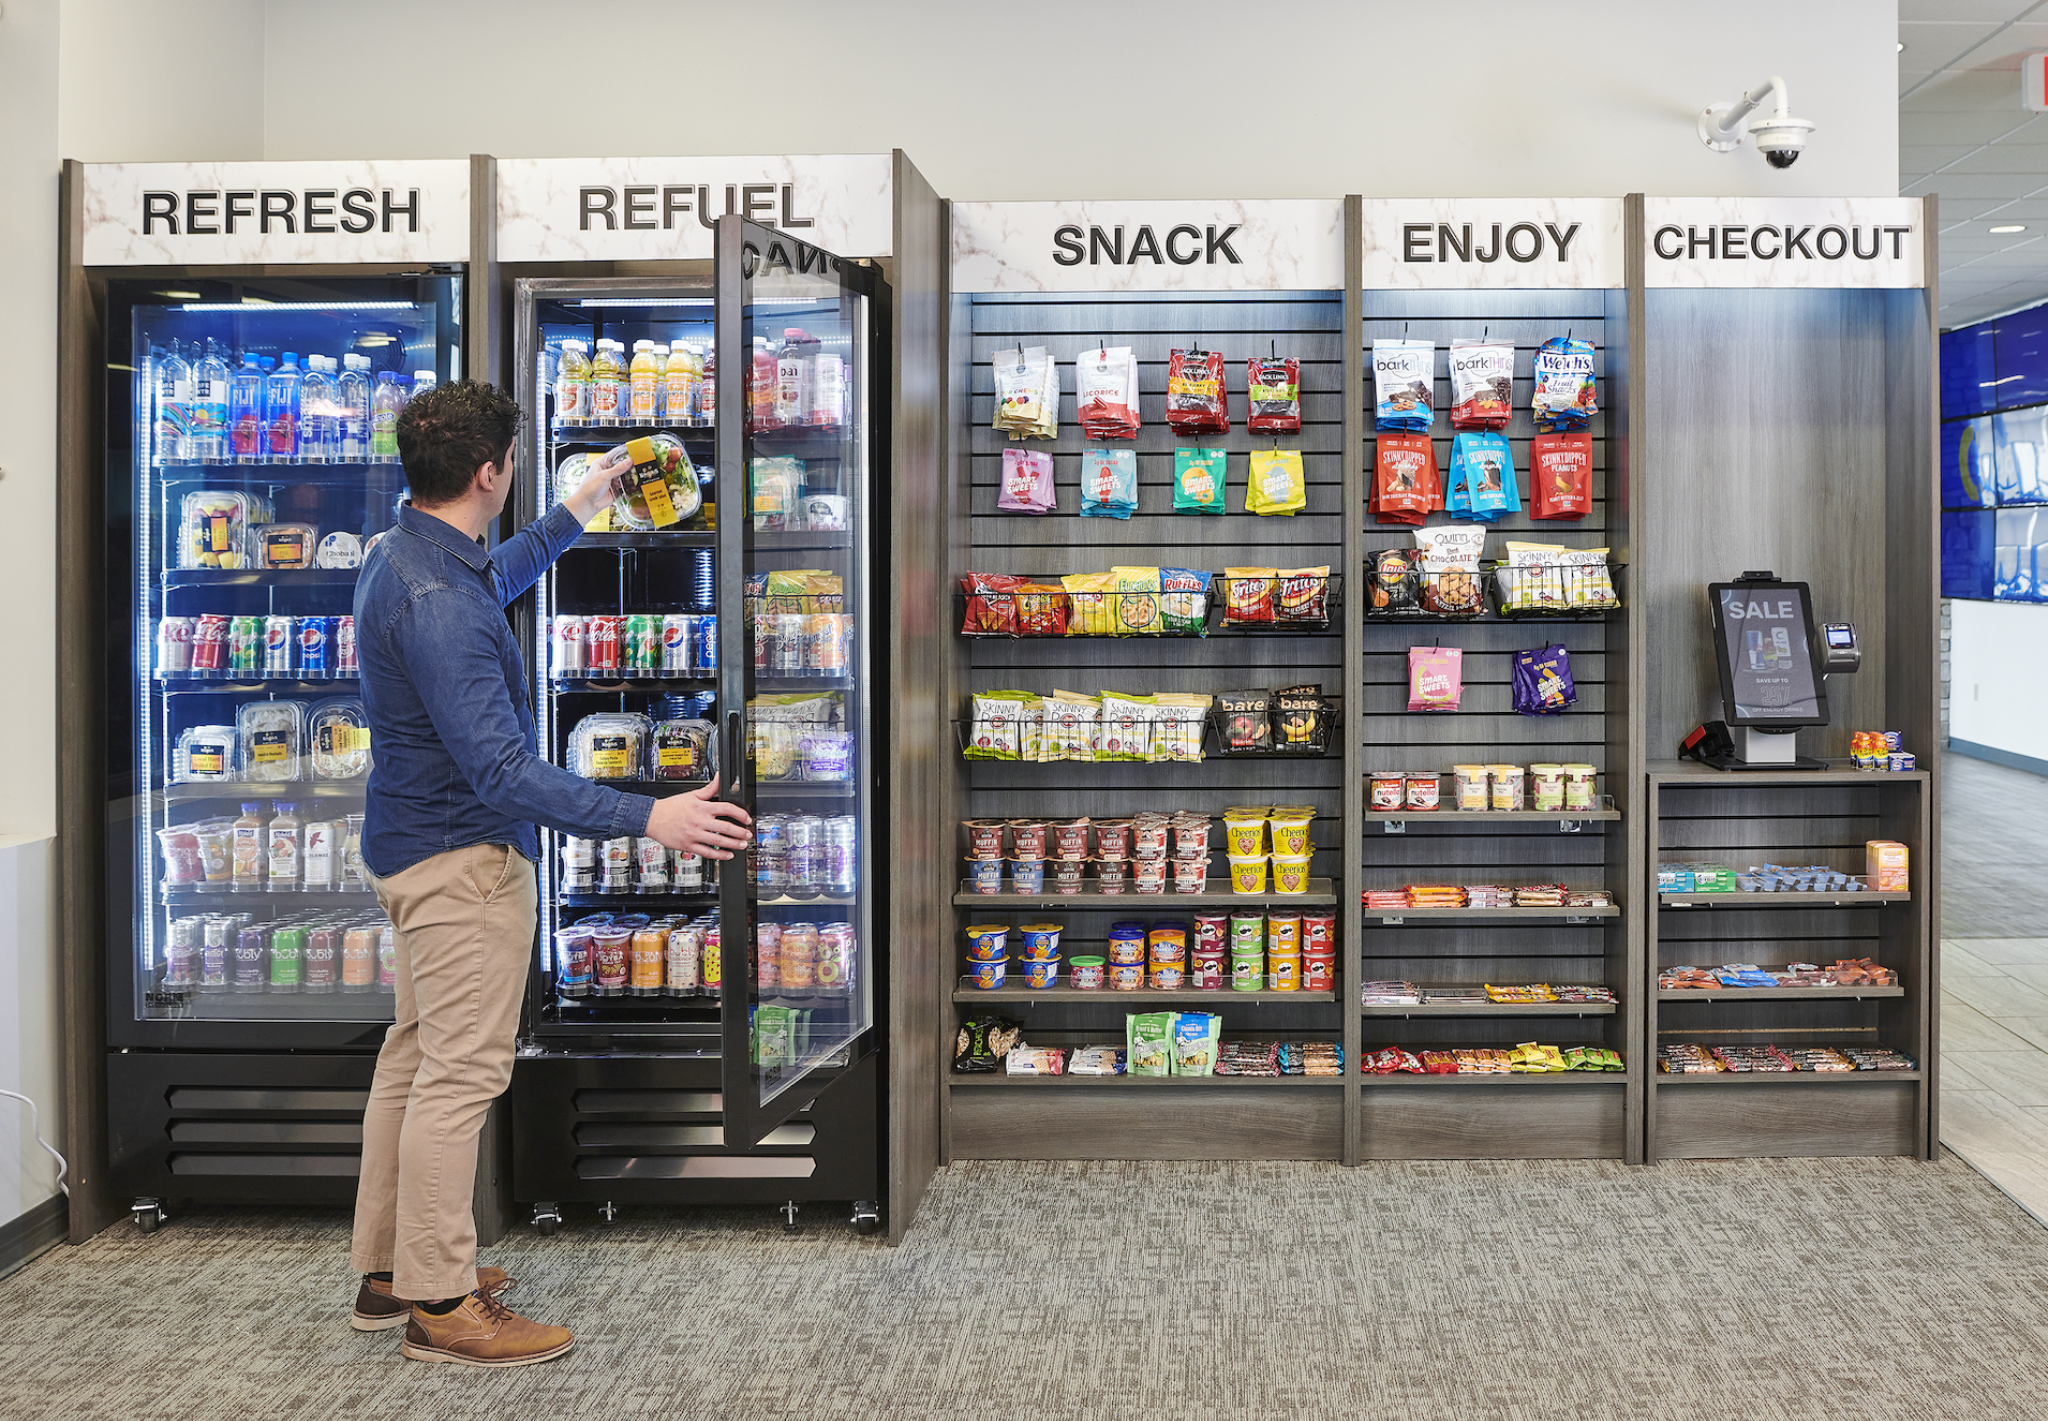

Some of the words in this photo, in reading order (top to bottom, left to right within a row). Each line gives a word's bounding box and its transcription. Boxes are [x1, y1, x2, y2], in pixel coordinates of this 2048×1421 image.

[143, 188, 420, 236] REFRESH
[579, 183, 814, 231] REFUEL
[1052, 223, 1243, 266] SNACK
[1403, 221, 1582, 263] ENJOY
[1653, 223, 1912, 260] CHECKOUT
[1543, 355, 1590, 370] Welch's
[781, 366, 798, 377] bai
[1083, 389, 1119, 398] LICORICE
[1547, 384, 1576, 394] Snacks
[233, 388, 254, 405] FIJI
[270, 387, 292, 404] FIJI
[1383, 451, 1425, 465] SKINNYDIPPED
[1541, 452, 1586, 467] SKINNYDIPPED
[1551, 464, 1577, 472] PEANUTS
[1008, 476, 1036, 487] SMART
[1090, 475, 1118, 486] SMART
[1185, 475, 1213, 487] SMART
[1263, 475, 1290, 487] SMART
[1007, 484, 1038, 494] SWEETS
[1090, 483, 1121, 494] SWEETS
[1184, 484, 1215, 495] SWEETS
[1263, 482, 1294, 495] SWEETS
[325, 549, 355, 558] Chobani
[1430, 554, 1472, 563] CHOCOLATE
[1517, 552, 1552, 562] SKINNY
[1568, 553, 1601, 564] SKINNY
[1165, 579, 1202, 591] RUFFLES
[1232, 580, 1266, 600] Fritos
[1280, 576, 1319, 597] Fritos
[1728, 601, 1794, 619] SALE
[705, 627, 715, 658] pepsi
[303, 652, 320, 660] pepsi
[1419, 675, 1448, 686] SMART
[1537, 676, 1561, 691] SMART
[1418, 682, 1450, 694] SWEETS
[1540, 683, 1566, 700] SWEETS
[983, 701, 1017, 713] SKINNY
[1053, 702, 1087, 715] SKINNY
[1111, 702, 1146, 715] SKINNY
[1222, 699, 1265, 711] bare
[1280, 697, 1317, 710] bare
[1155, 708, 1190, 716] SKINNY
[1377, 788, 1400, 796] nutella
[1410, 788, 1435, 796] nutella
[1231, 827, 1261, 838] Cheerios
[1281, 827, 1308, 838] Cheerio
[1059, 838, 1082, 846] MUFFIN
[1233, 864, 1263, 874] Cheerios
[1275, 864, 1306, 874] Cheerios
[344, 949, 372, 961] bubly
[669, 946, 697, 958] bubly
